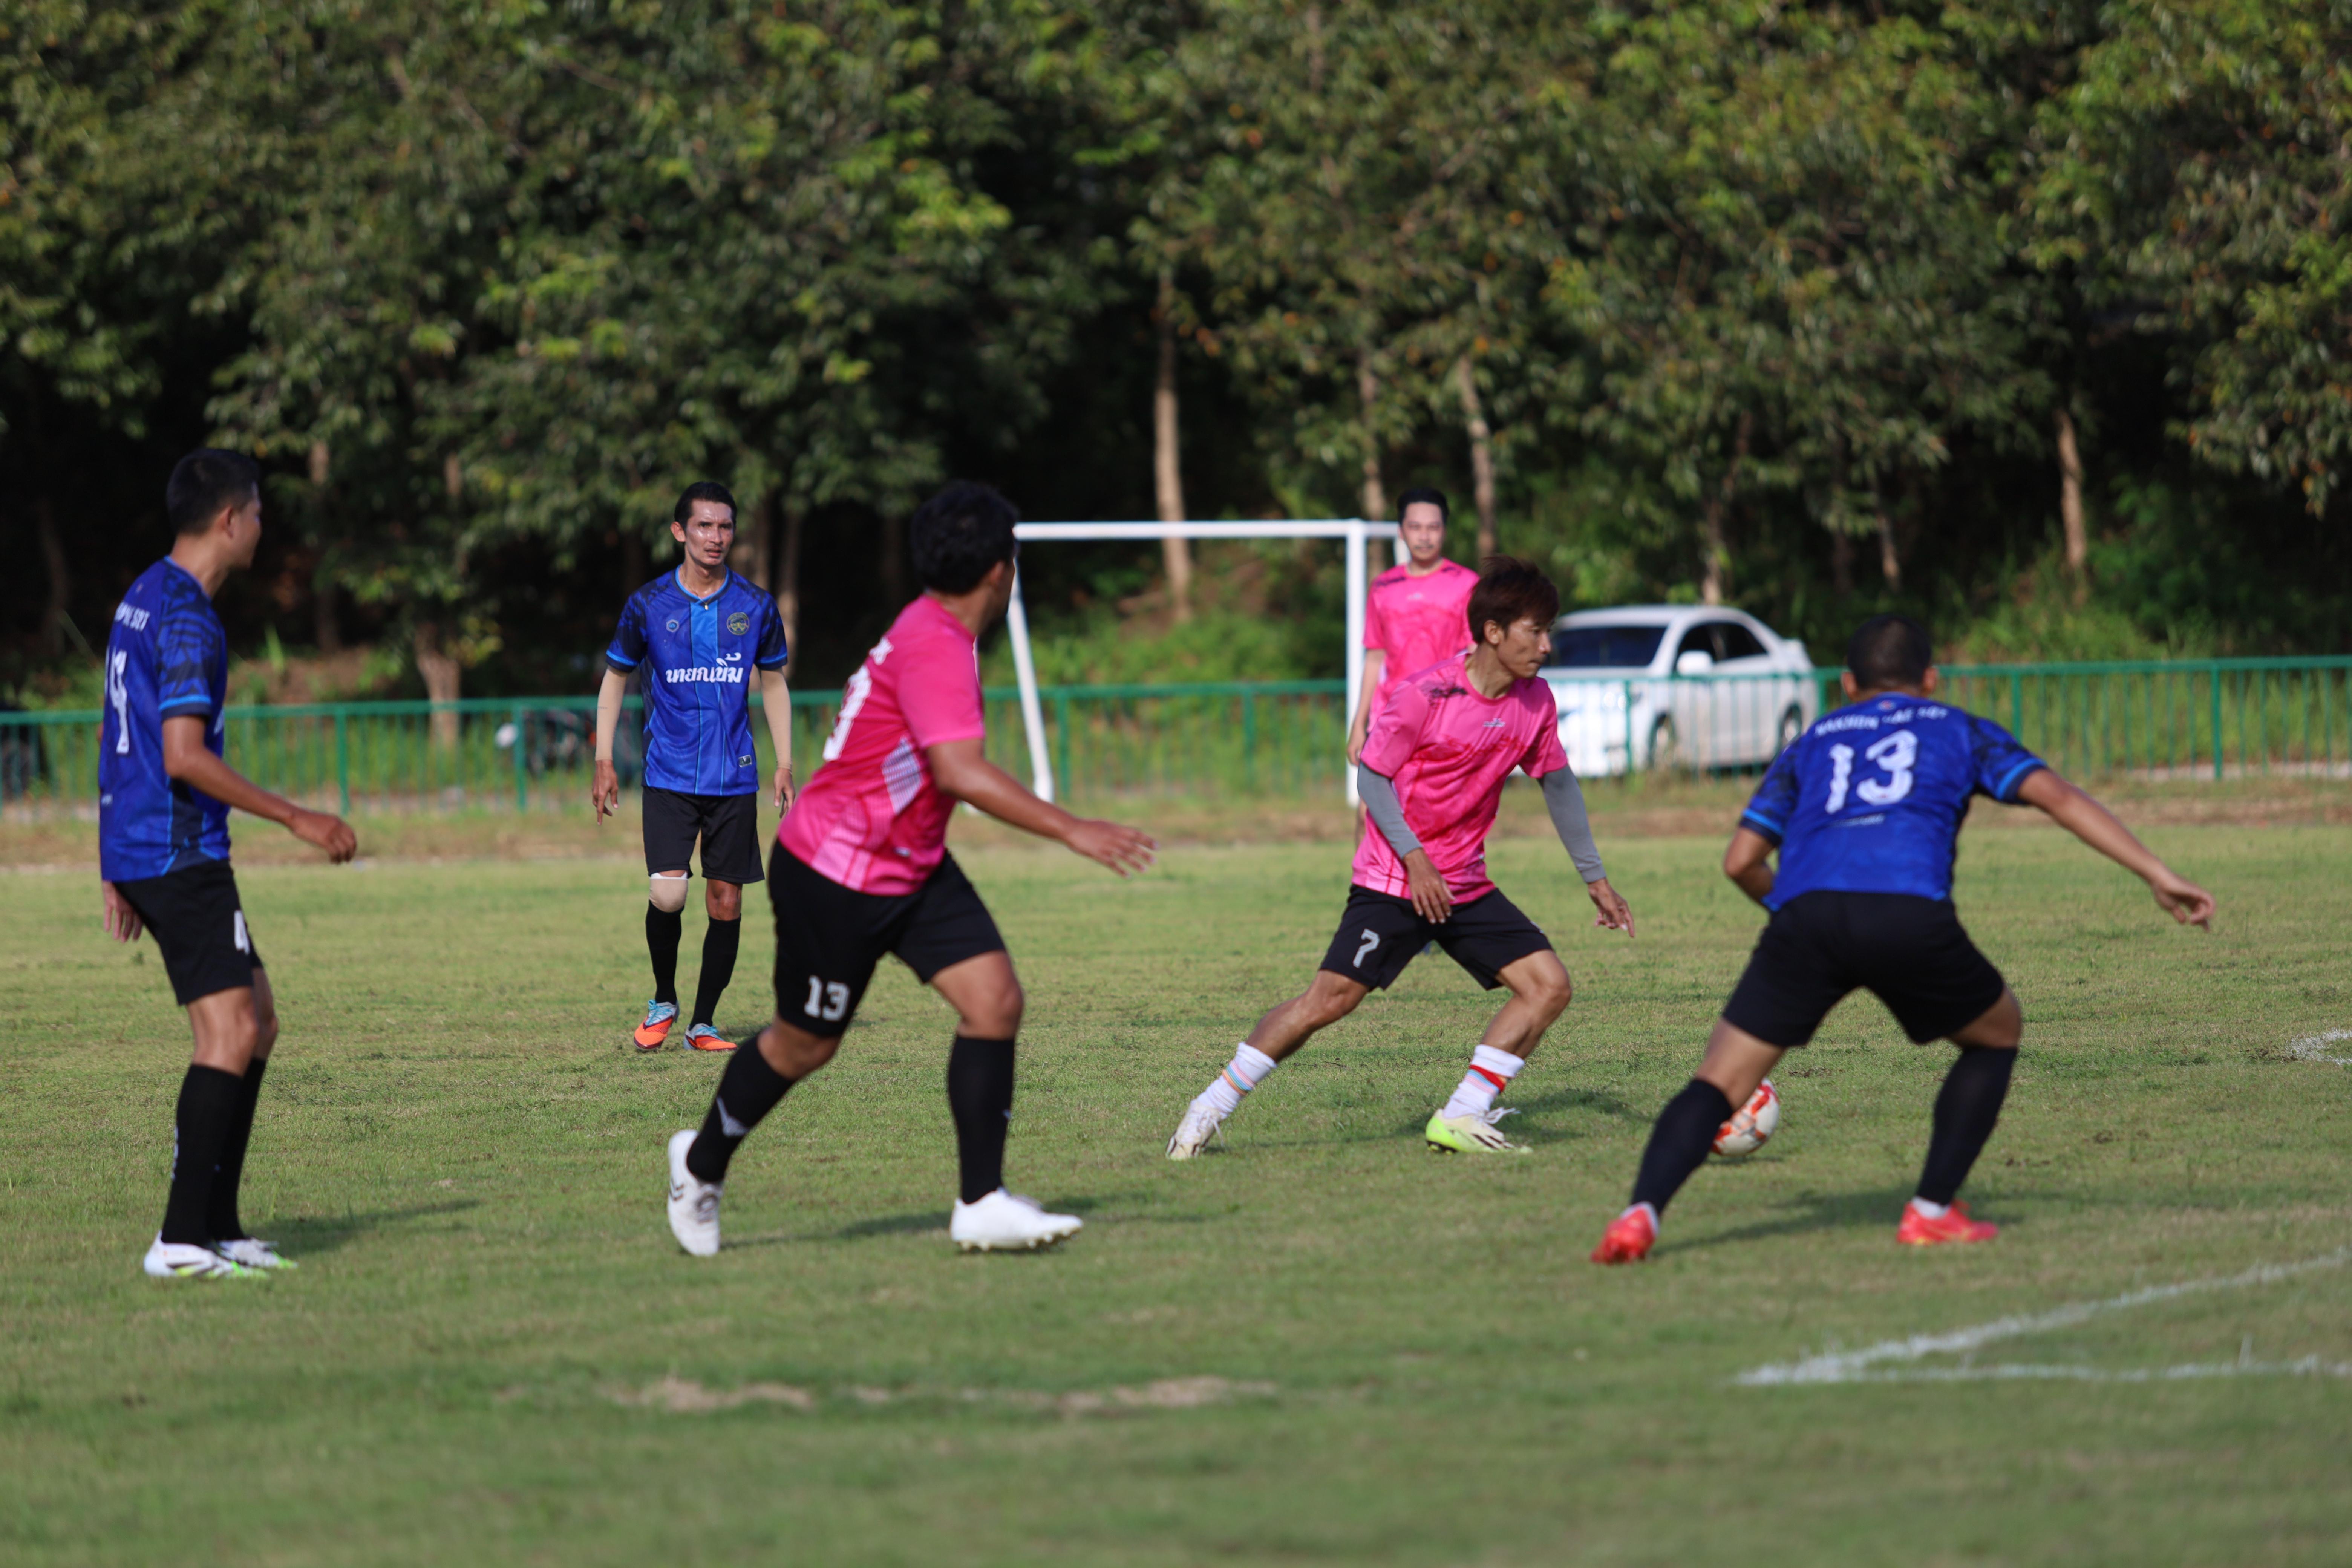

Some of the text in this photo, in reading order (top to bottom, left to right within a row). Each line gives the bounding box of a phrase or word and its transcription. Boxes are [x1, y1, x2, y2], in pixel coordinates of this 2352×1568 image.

[1825, 729, 1918, 815] 13
[1352, 928, 1380, 968] 7
[804, 975, 851, 1021] 13
